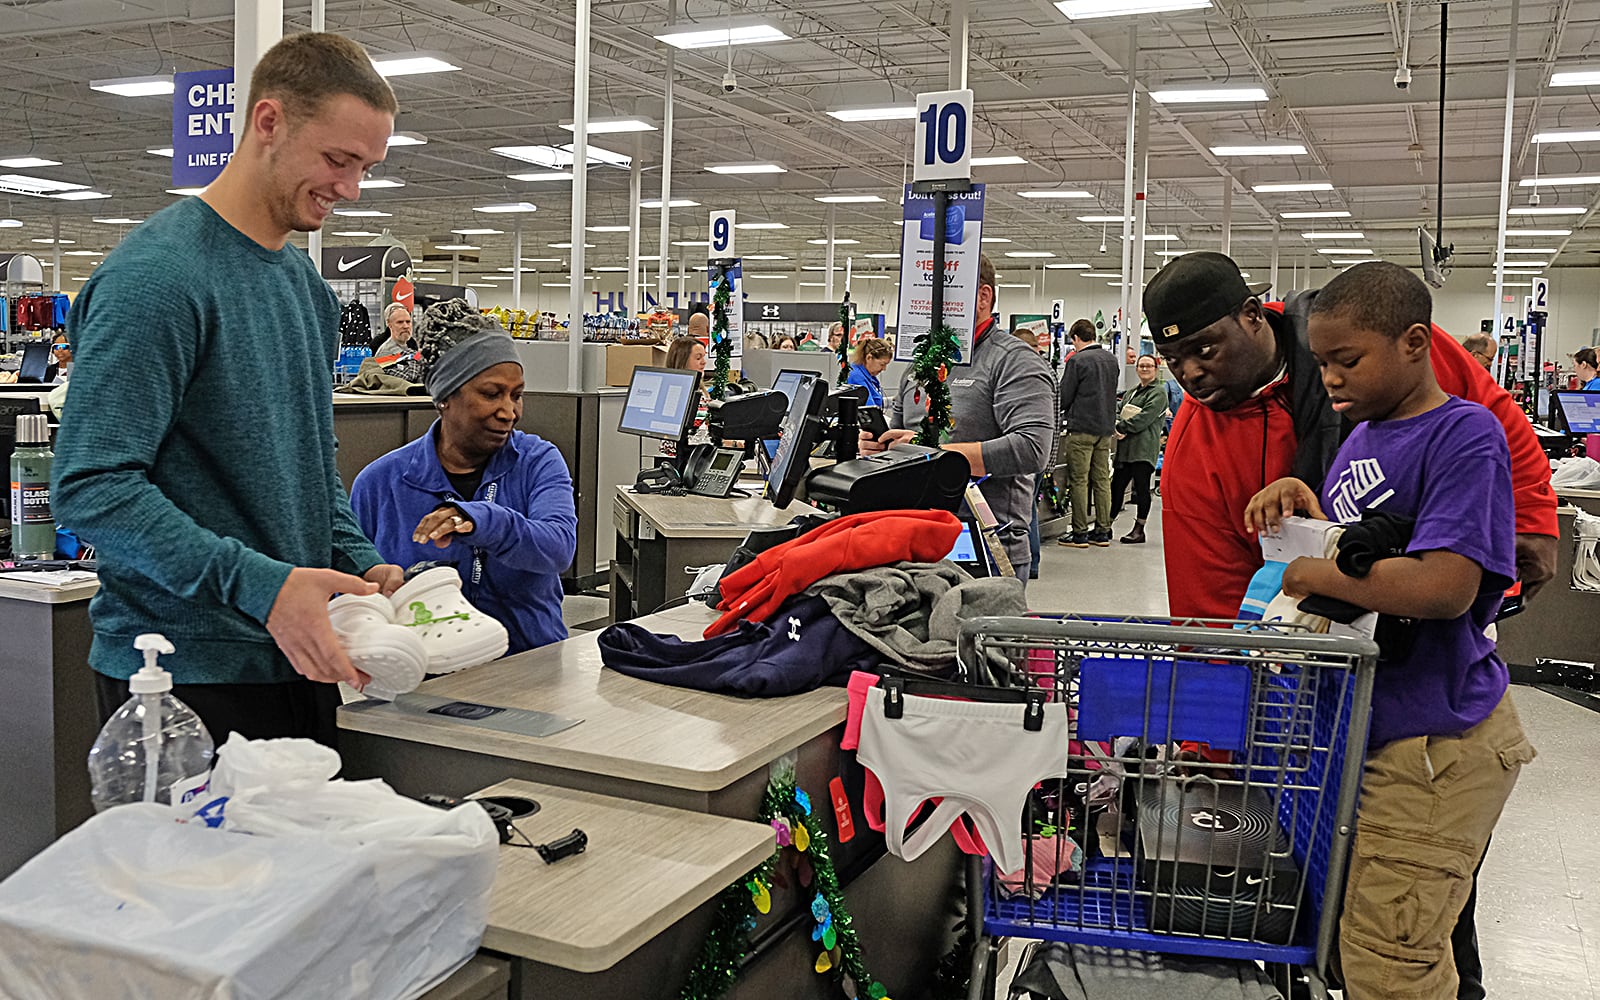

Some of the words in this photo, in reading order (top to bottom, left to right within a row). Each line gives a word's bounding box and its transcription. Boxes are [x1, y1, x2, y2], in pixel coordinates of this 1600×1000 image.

[919, 102, 966, 165] 10
[188, 153, 218, 167] LINE
[713, 217, 729, 251] 9
[1537, 282, 1546, 307] 2
[1053, 303, 1060, 319] 6
[1112, 315, 1117, 328] 5
[1504, 316, 1514, 332] 4
